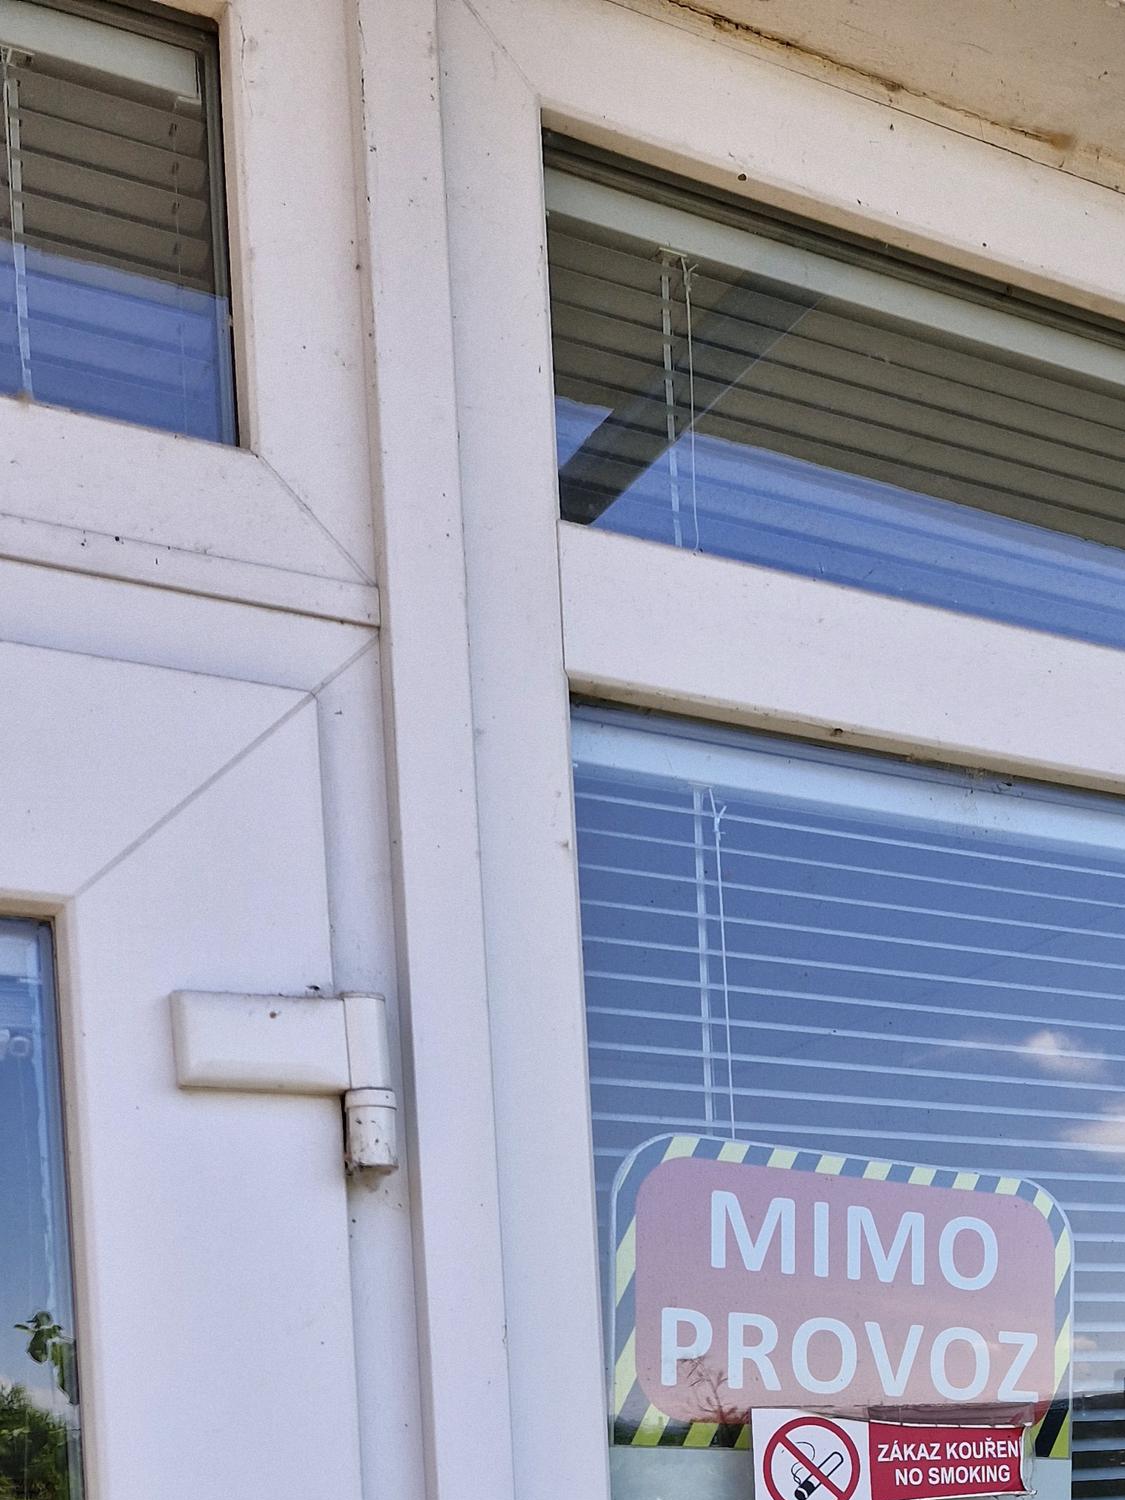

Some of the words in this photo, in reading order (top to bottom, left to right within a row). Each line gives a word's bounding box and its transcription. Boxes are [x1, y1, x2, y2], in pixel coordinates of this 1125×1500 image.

[710, 1190, 999, 1291] MIMO
[660, 1307, 1039, 1402] PROVOZ
[877, 1441, 941, 1462] ZÁKAZ
[895, 1468, 923, 1486] NO
[928, 1464, 1010, 1485] SMOKING
